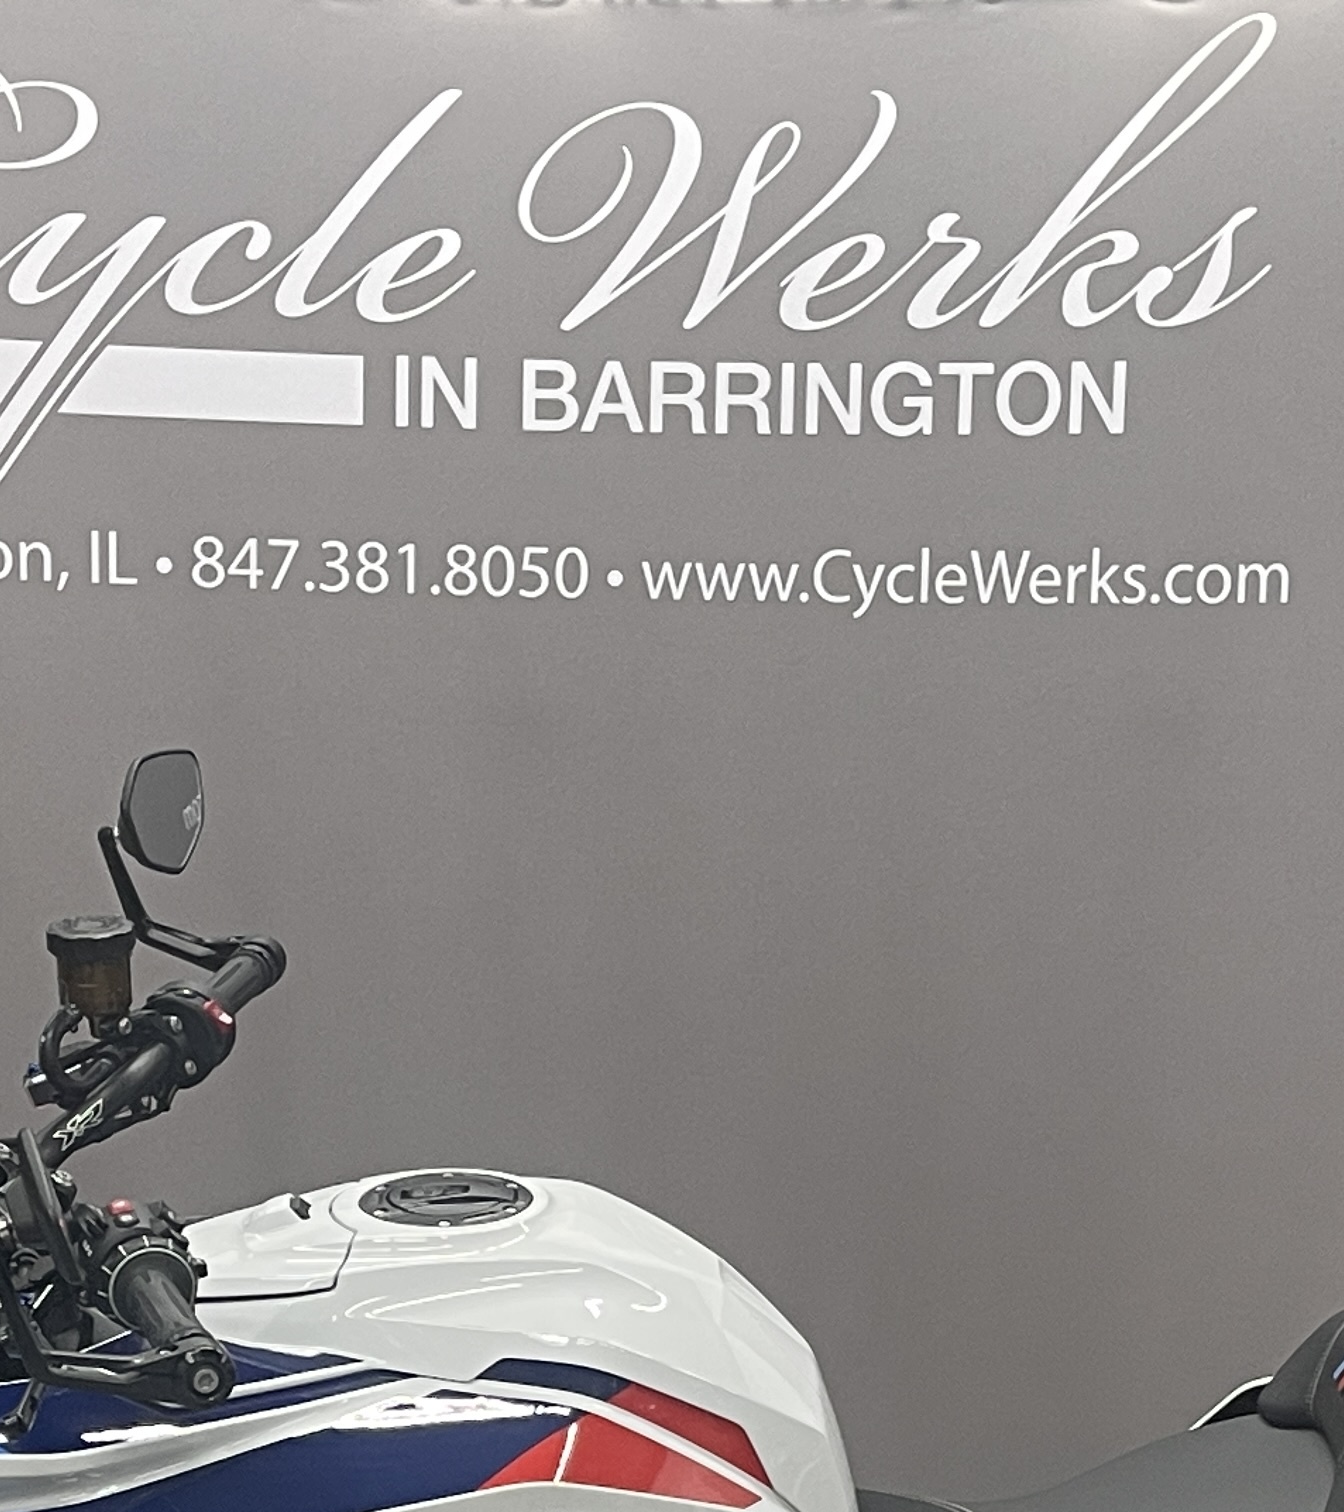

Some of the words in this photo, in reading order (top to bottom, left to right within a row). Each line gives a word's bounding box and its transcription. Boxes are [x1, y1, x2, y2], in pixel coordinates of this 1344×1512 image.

[517, 12, 1278, 331] Werks
[394, 354, 479, 430] IN
[521, 357, 1128, 438] BARRINGTON
[89, 530, 139, 586] IL
[191, 535, 590, 600] 847.381.8050
[640, 547, 1290, 620] www.CycleWerks.com
